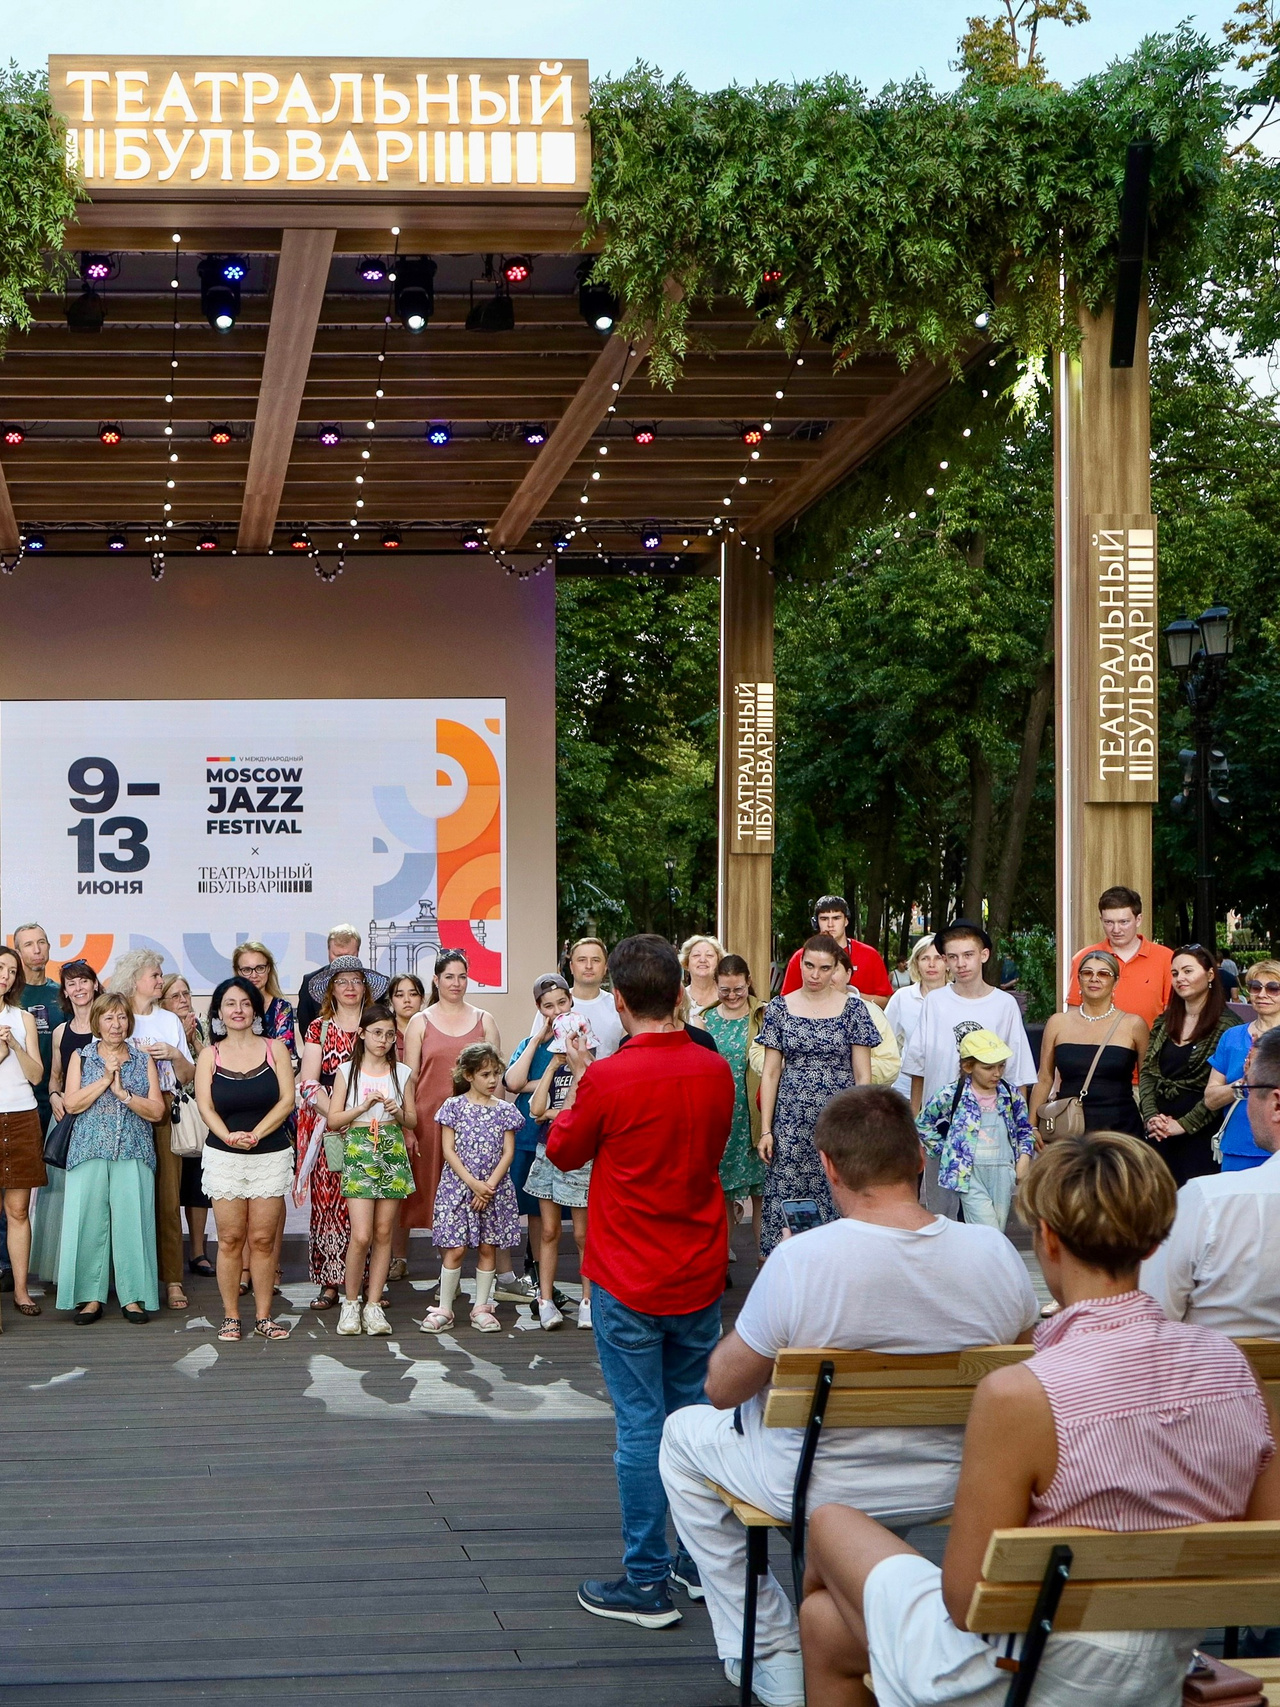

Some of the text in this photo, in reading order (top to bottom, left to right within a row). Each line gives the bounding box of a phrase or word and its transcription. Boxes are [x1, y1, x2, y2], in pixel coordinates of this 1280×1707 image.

[66, 61, 573, 126] ТЕАТРАЛЬНЫЙ
[114, 128, 414, 182] БУЛЬВАР
[1092, 529, 1125, 781] ТЕАТРАЛЬНЫЙ
[1128, 608, 1155, 757] БУЛЬВАР
[206, 768, 303, 783] MOSCOW
[734, 682, 756, 841] ТЕАТРАЛЬНЫЙ
[756, 732, 774, 826] БУЛЬВАР
[206, 819, 302, 834] FESTIVAL
[207, 786, 304, 814] JAZZ
[67, 816, 151, 873] 13
[198, 863, 312, 880] ТЕАТРАЛЬНЫЙ
[77, 880, 143, 894] ИЮНЯ
[209, 880, 276, 894] БУЛЬВАР
